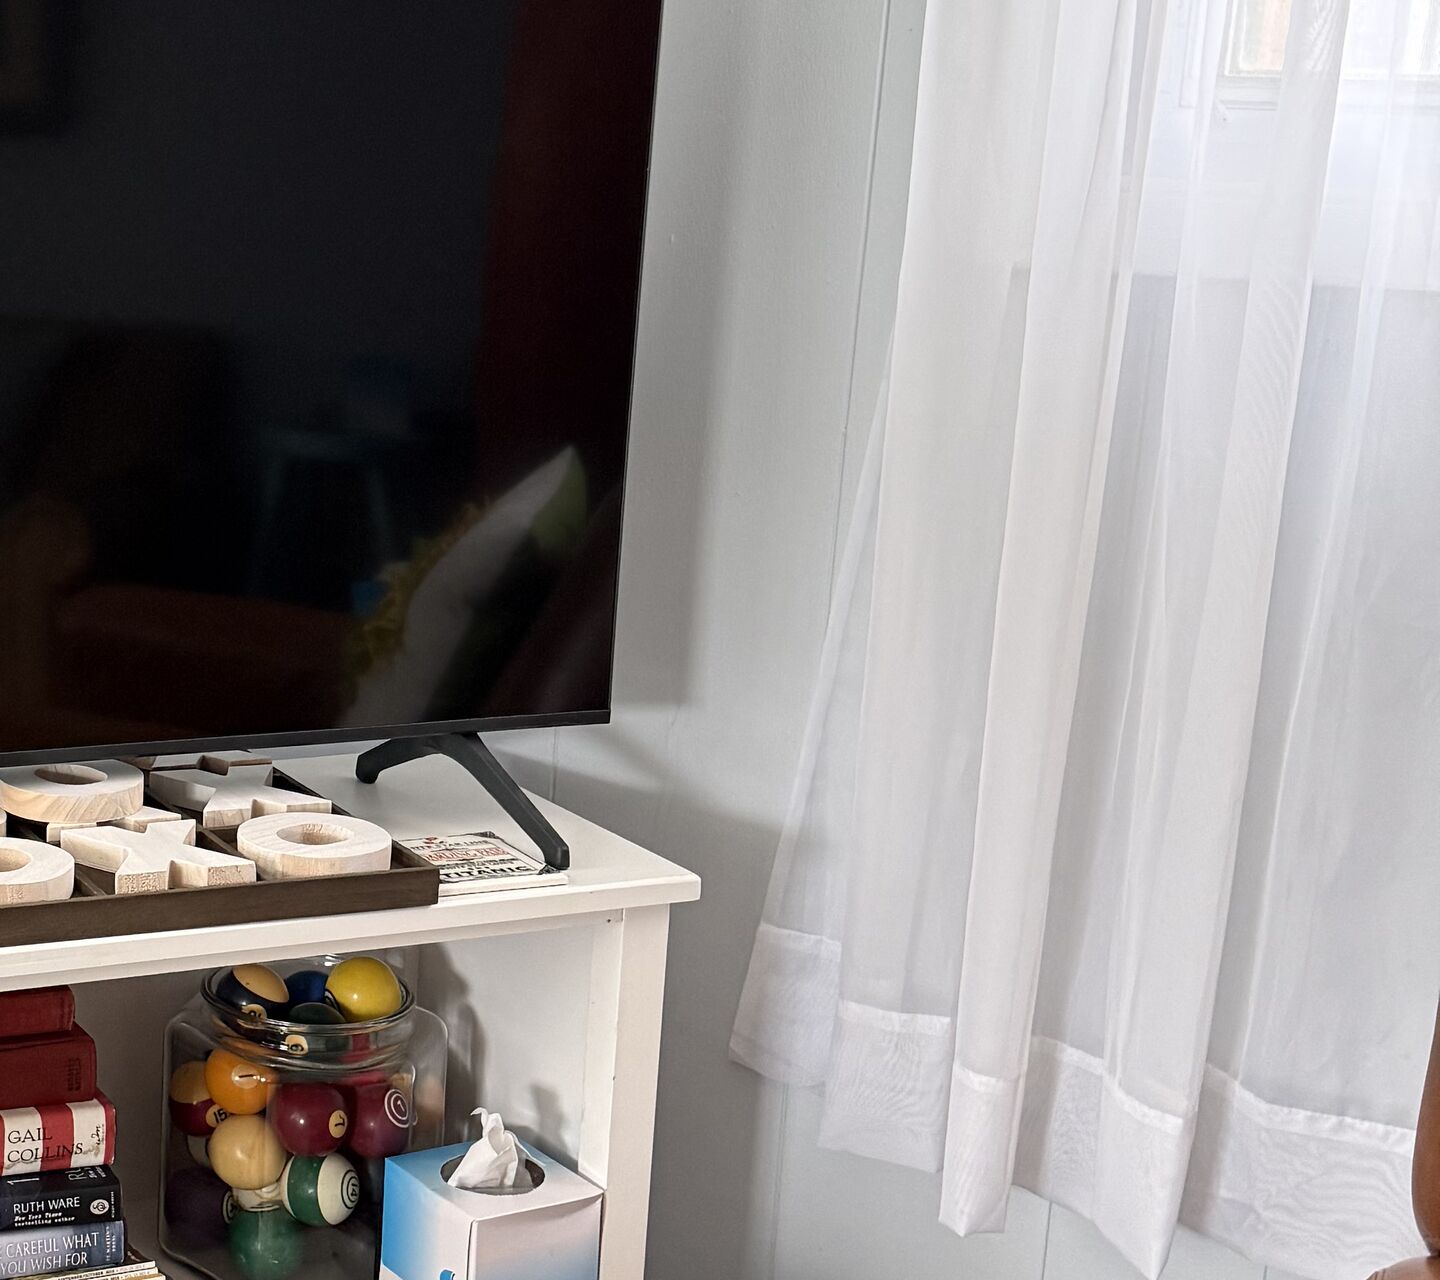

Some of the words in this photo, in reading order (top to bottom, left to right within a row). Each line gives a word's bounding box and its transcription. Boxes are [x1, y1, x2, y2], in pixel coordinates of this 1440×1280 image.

[440, 865, 534, 878] TITANIC
[7, 1127, 53, 1145] GAIL
[7, 1142, 84, 1164] COLLINS
[13, 1200, 45, 1215] RUTH
[48, 1196, 81, 1210] WARE
[6, 1238, 60, 1258] CAREFUL
[62, 1231, 100, 1251] WHAT
[0, 1259, 27, 1276] YOU
[29, 1255, 62, 1273] WISH
[65, 1251, 89, 1268] FOR
